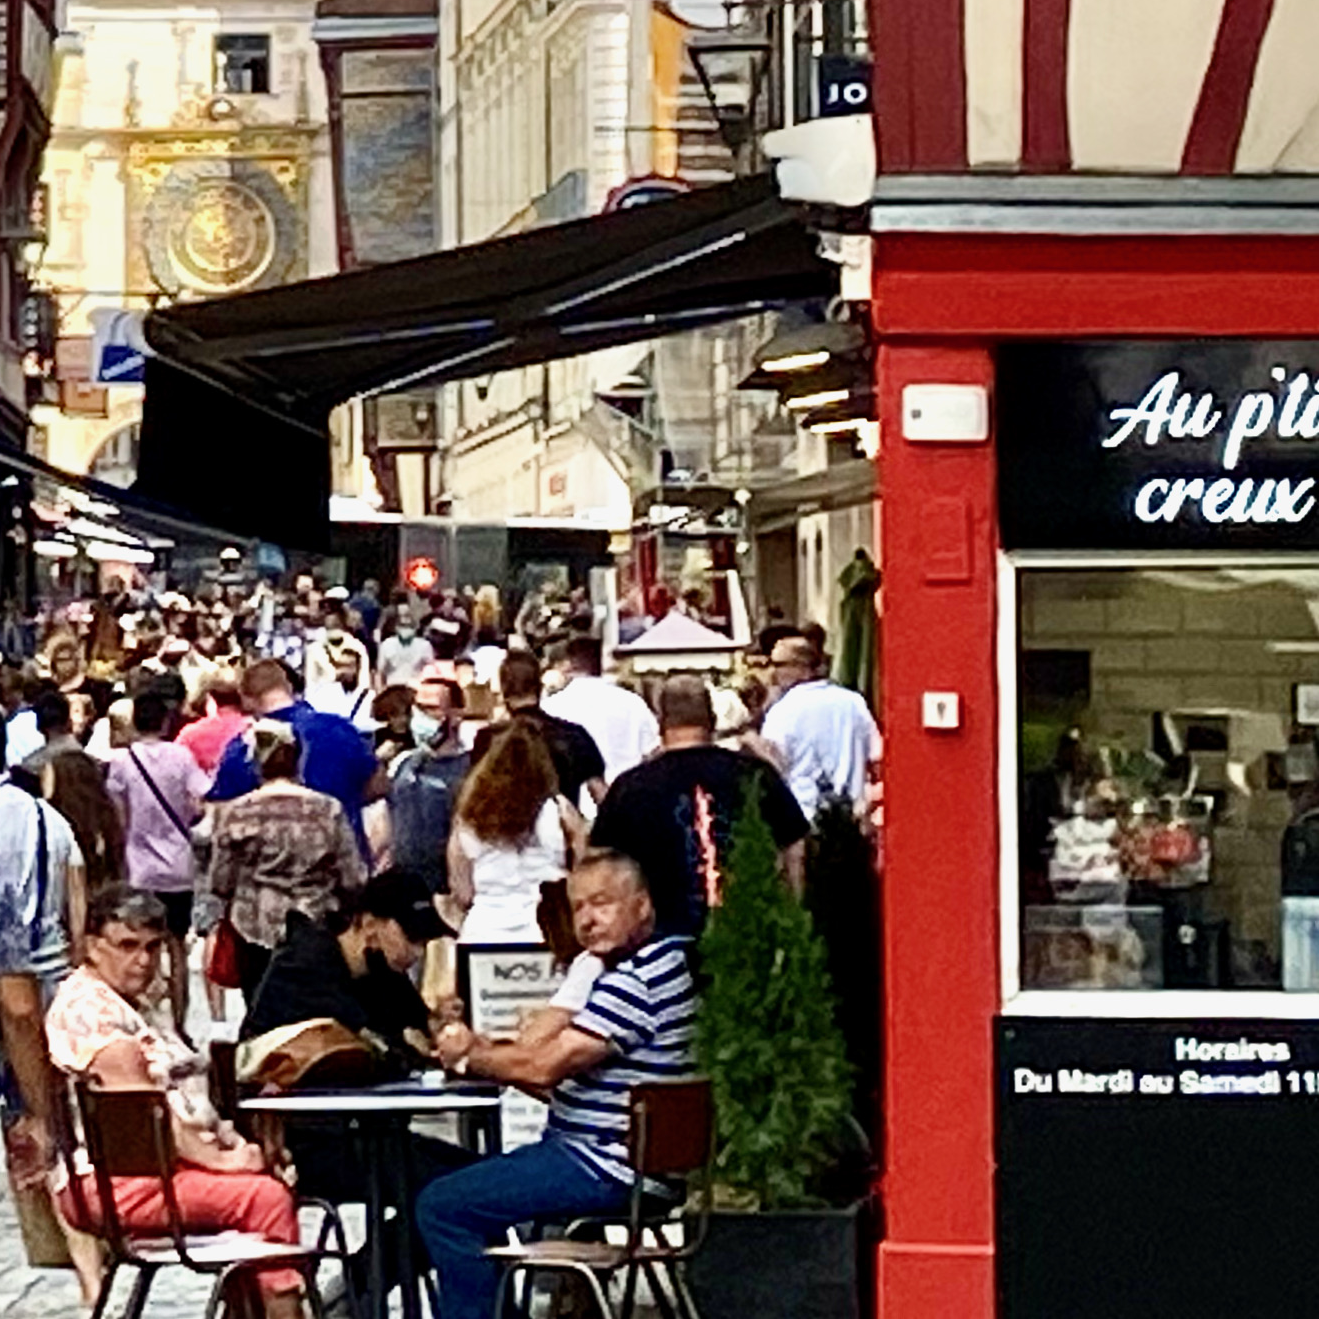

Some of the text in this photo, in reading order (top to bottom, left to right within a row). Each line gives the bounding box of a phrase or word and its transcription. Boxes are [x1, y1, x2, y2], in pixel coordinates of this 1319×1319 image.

[1101, 371, 1222, 448] Au
[1135, 477, 1317, 523] creux
[1175, 1037, 1291, 1062] Horaires
[1013, 1067, 1053, 1094] Du
[1057, 1069, 1135, 1094] Mardi
[1139, 1074, 1174, 1095] au
[1179, 1069, 1282, 1095] Samedi
